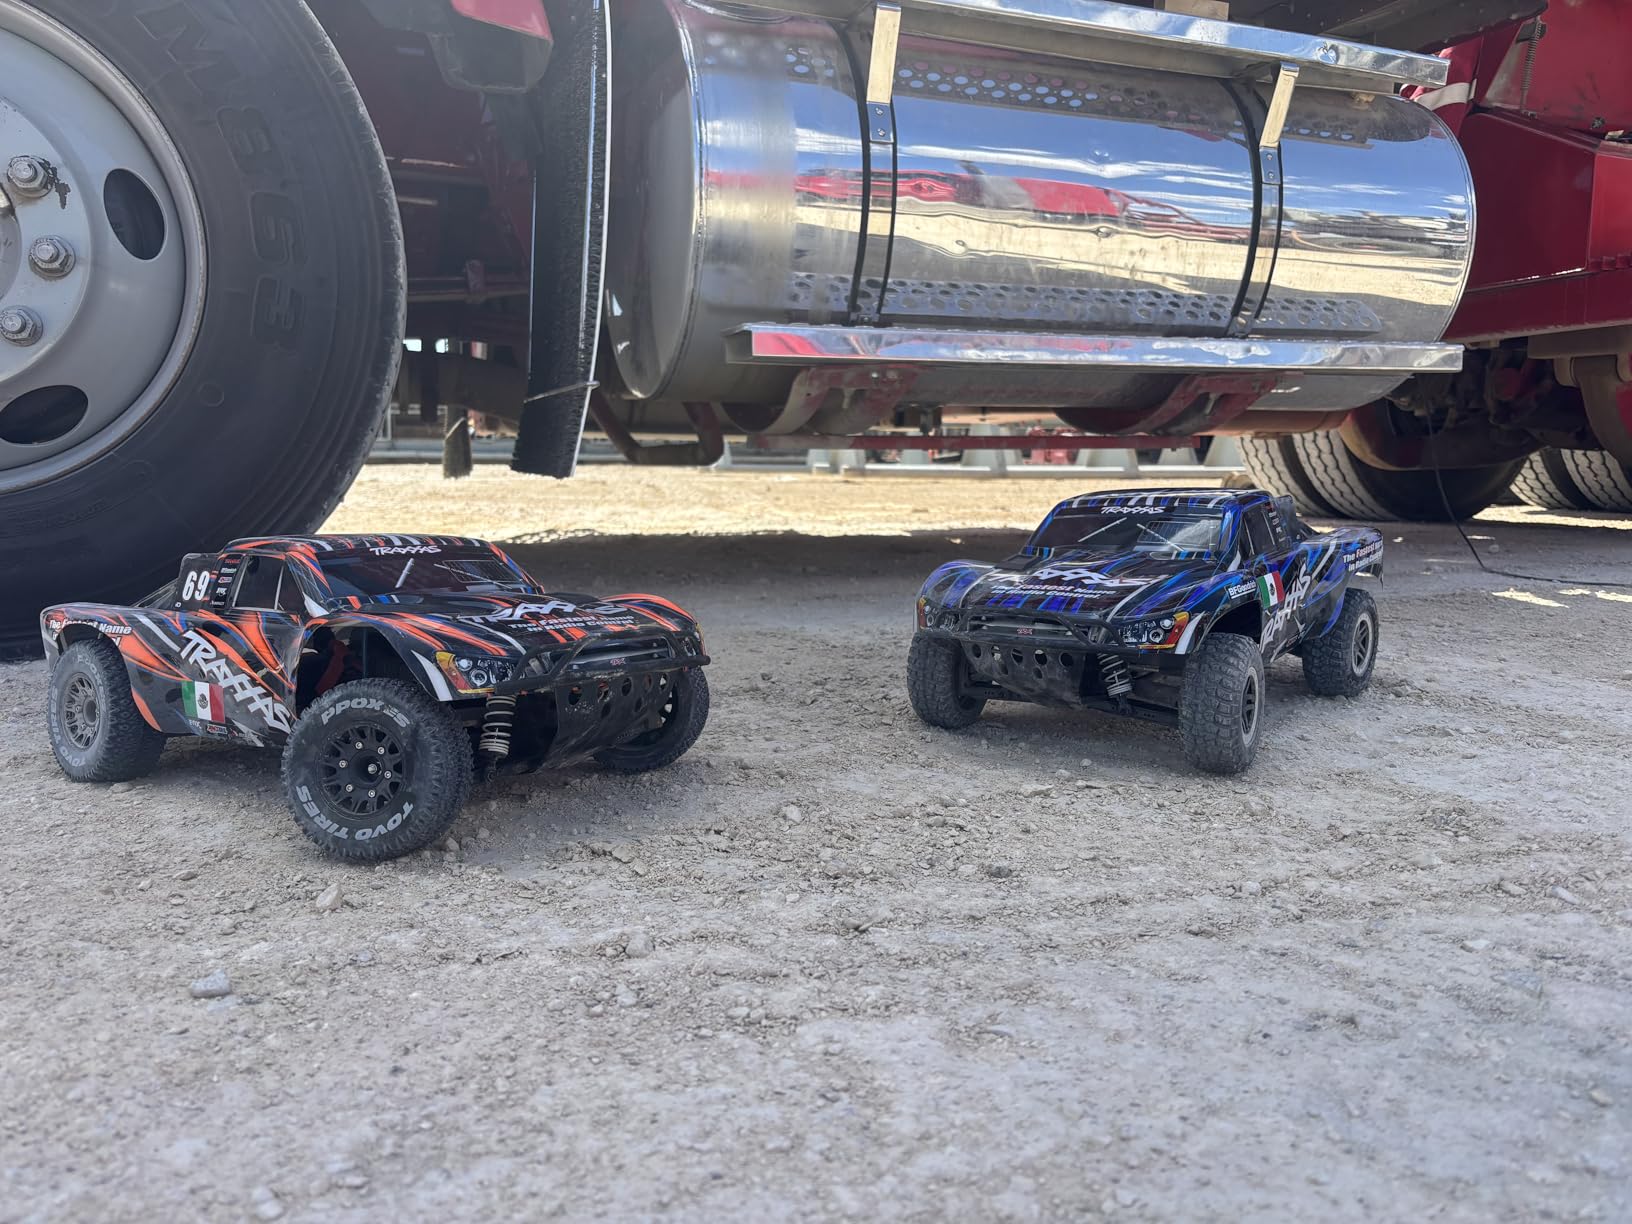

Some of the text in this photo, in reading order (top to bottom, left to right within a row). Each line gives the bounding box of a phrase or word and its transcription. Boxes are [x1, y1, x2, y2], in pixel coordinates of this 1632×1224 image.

[1100, 505, 1167, 514] TRAXXAS
[369, 545, 442, 556] TRAXXAS
[182, 570, 210, 601] 69
[99, 623, 133, 634] Name
[295, 784, 350, 840] TIRES
